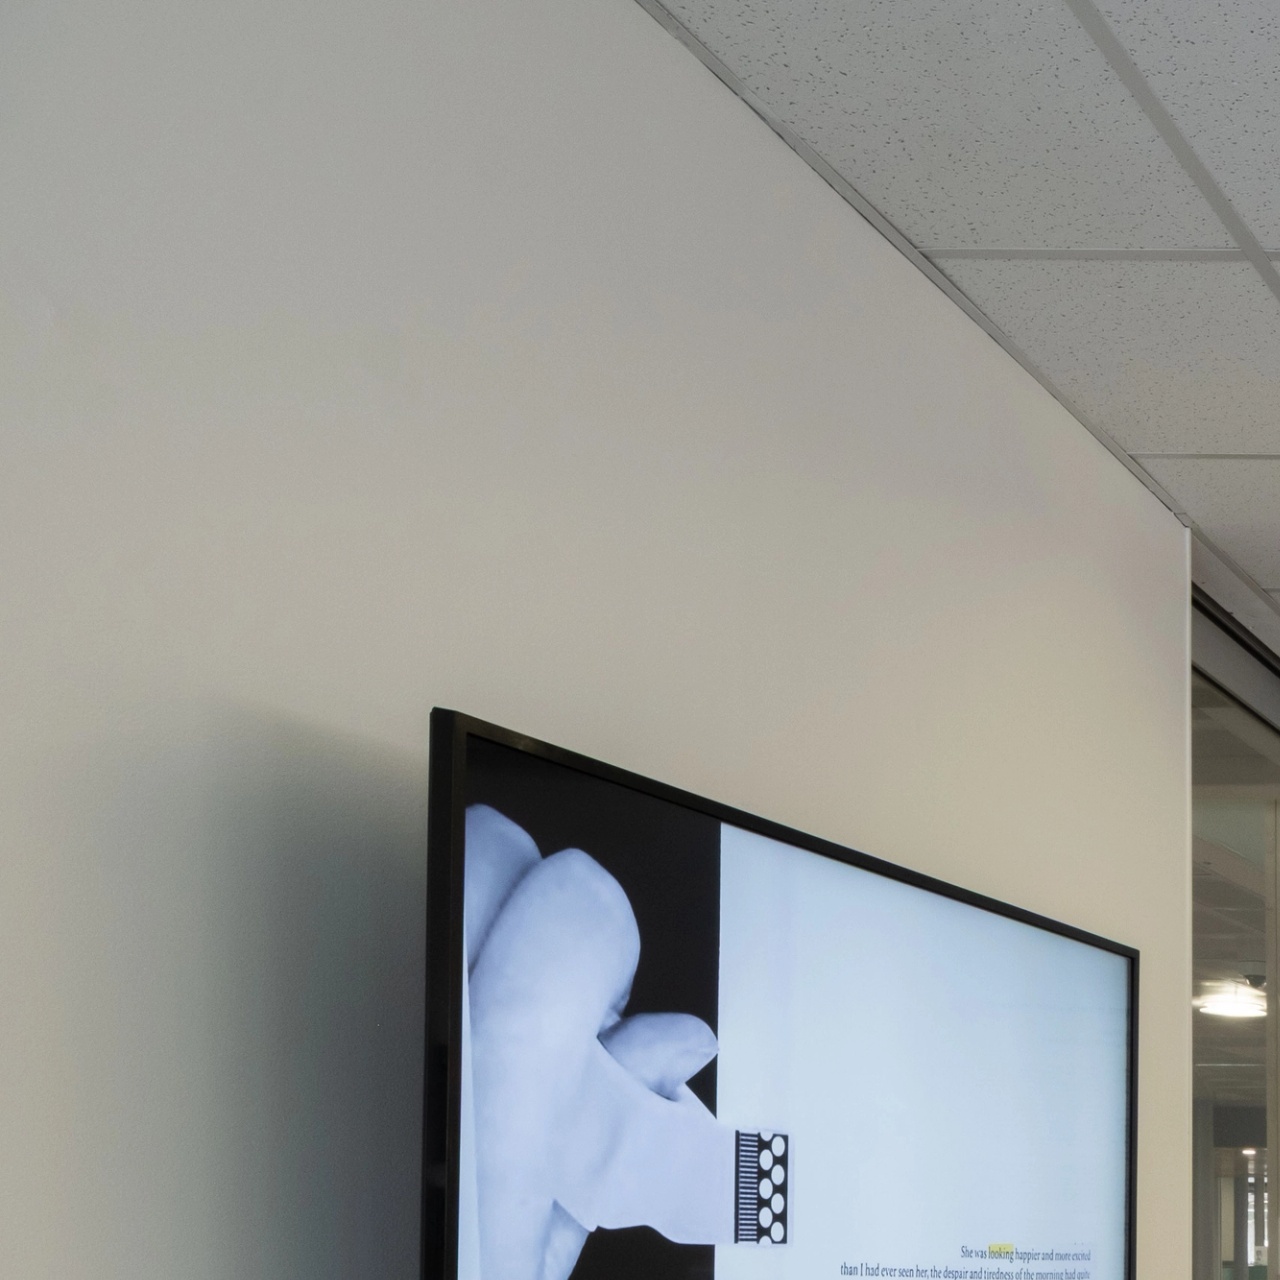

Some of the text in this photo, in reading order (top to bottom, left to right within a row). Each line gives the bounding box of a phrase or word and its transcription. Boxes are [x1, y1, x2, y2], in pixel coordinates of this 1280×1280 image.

[960, 1245, 1091, 1264] She was looking happier and more excited
[840, 1261, 858, 1276] than
[865, 1262, 880, 1277] had
[881, 1266, 897, 1278] ever
[898, 1267, 914, 1278] seen
[915, 1264, 930, 1280] her,
[930, 1264, 941, 1279] the
[969, 1266, 983, 1280] and
[983, 1267, 1014, 1280] tiredness
[1015, 1267, 1024, 1280] of
[1023, 1268, 1034, 1280] the
[1064, 1268, 1076, 1280] had
